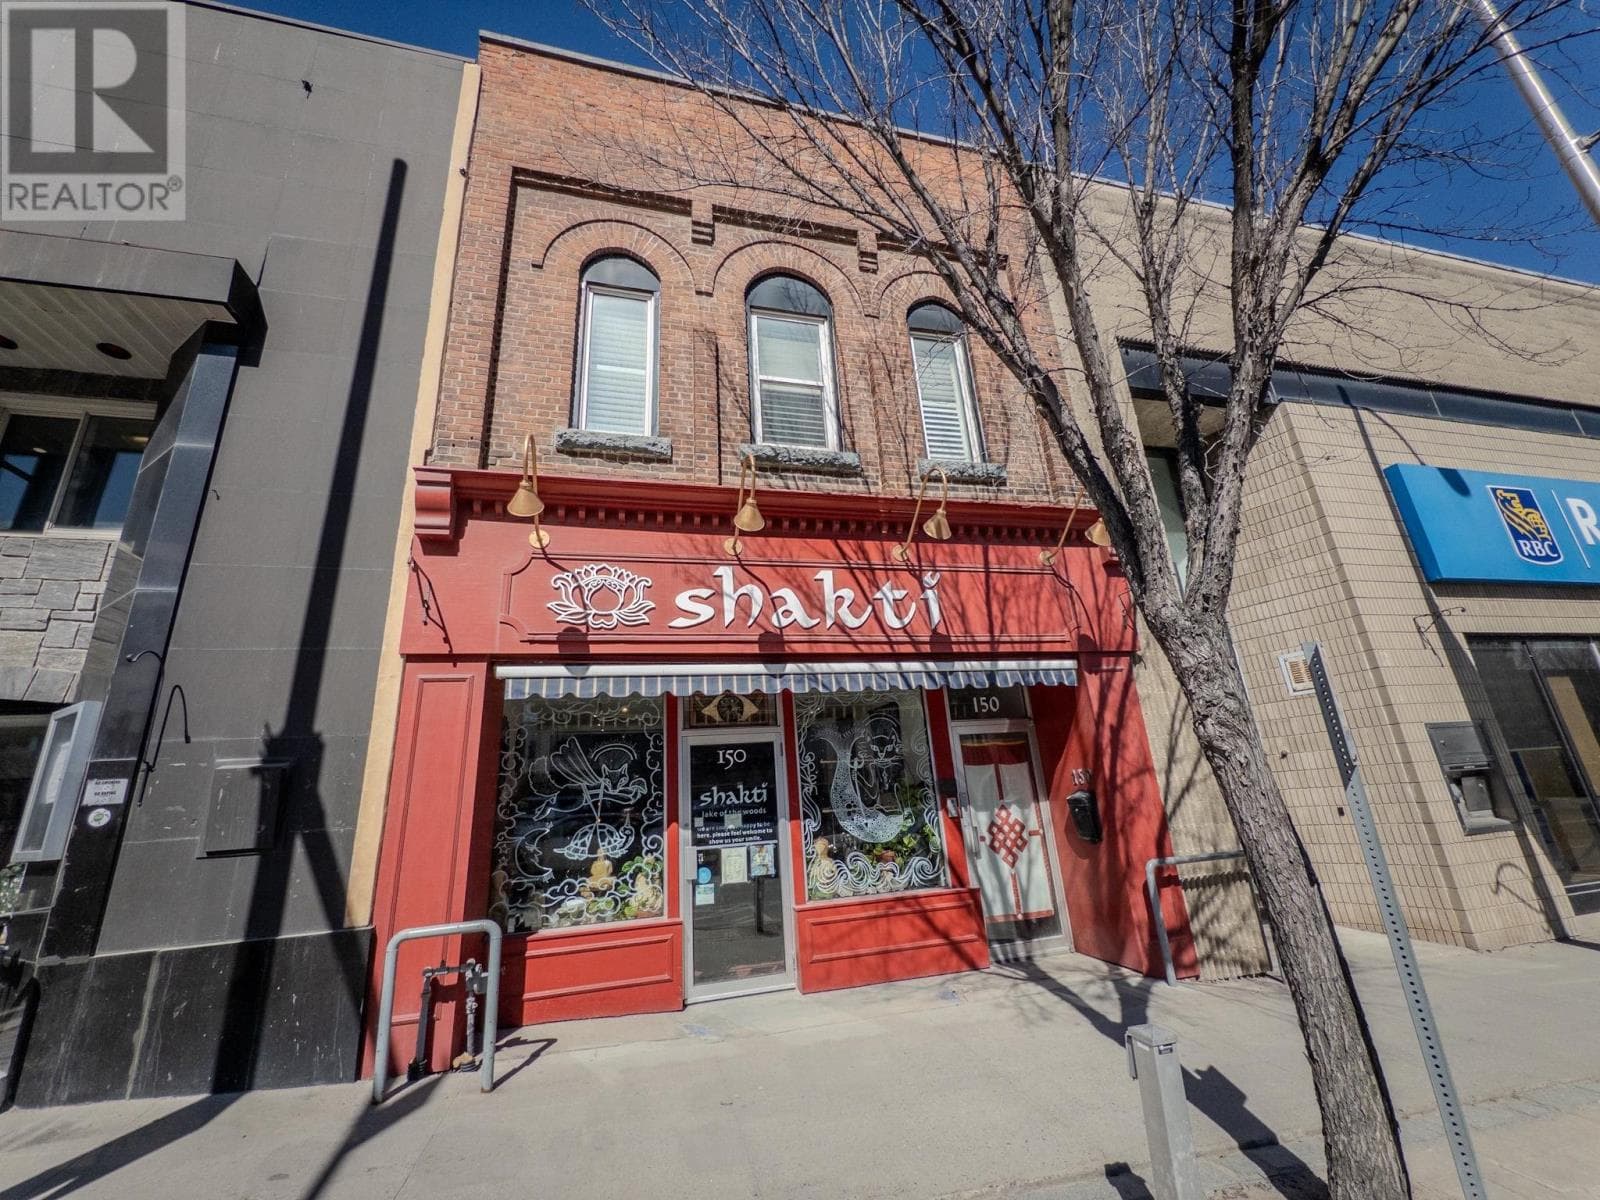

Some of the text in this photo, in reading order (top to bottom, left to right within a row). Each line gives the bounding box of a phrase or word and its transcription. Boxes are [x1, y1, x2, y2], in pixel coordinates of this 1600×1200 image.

[1518, 540, 1558, 557] RBC
[668, 565, 940, 629] shakti
[973, 696, 1000, 712] 150
[717, 749, 747, 770] 150
[699, 782, 768, 806] shakti
